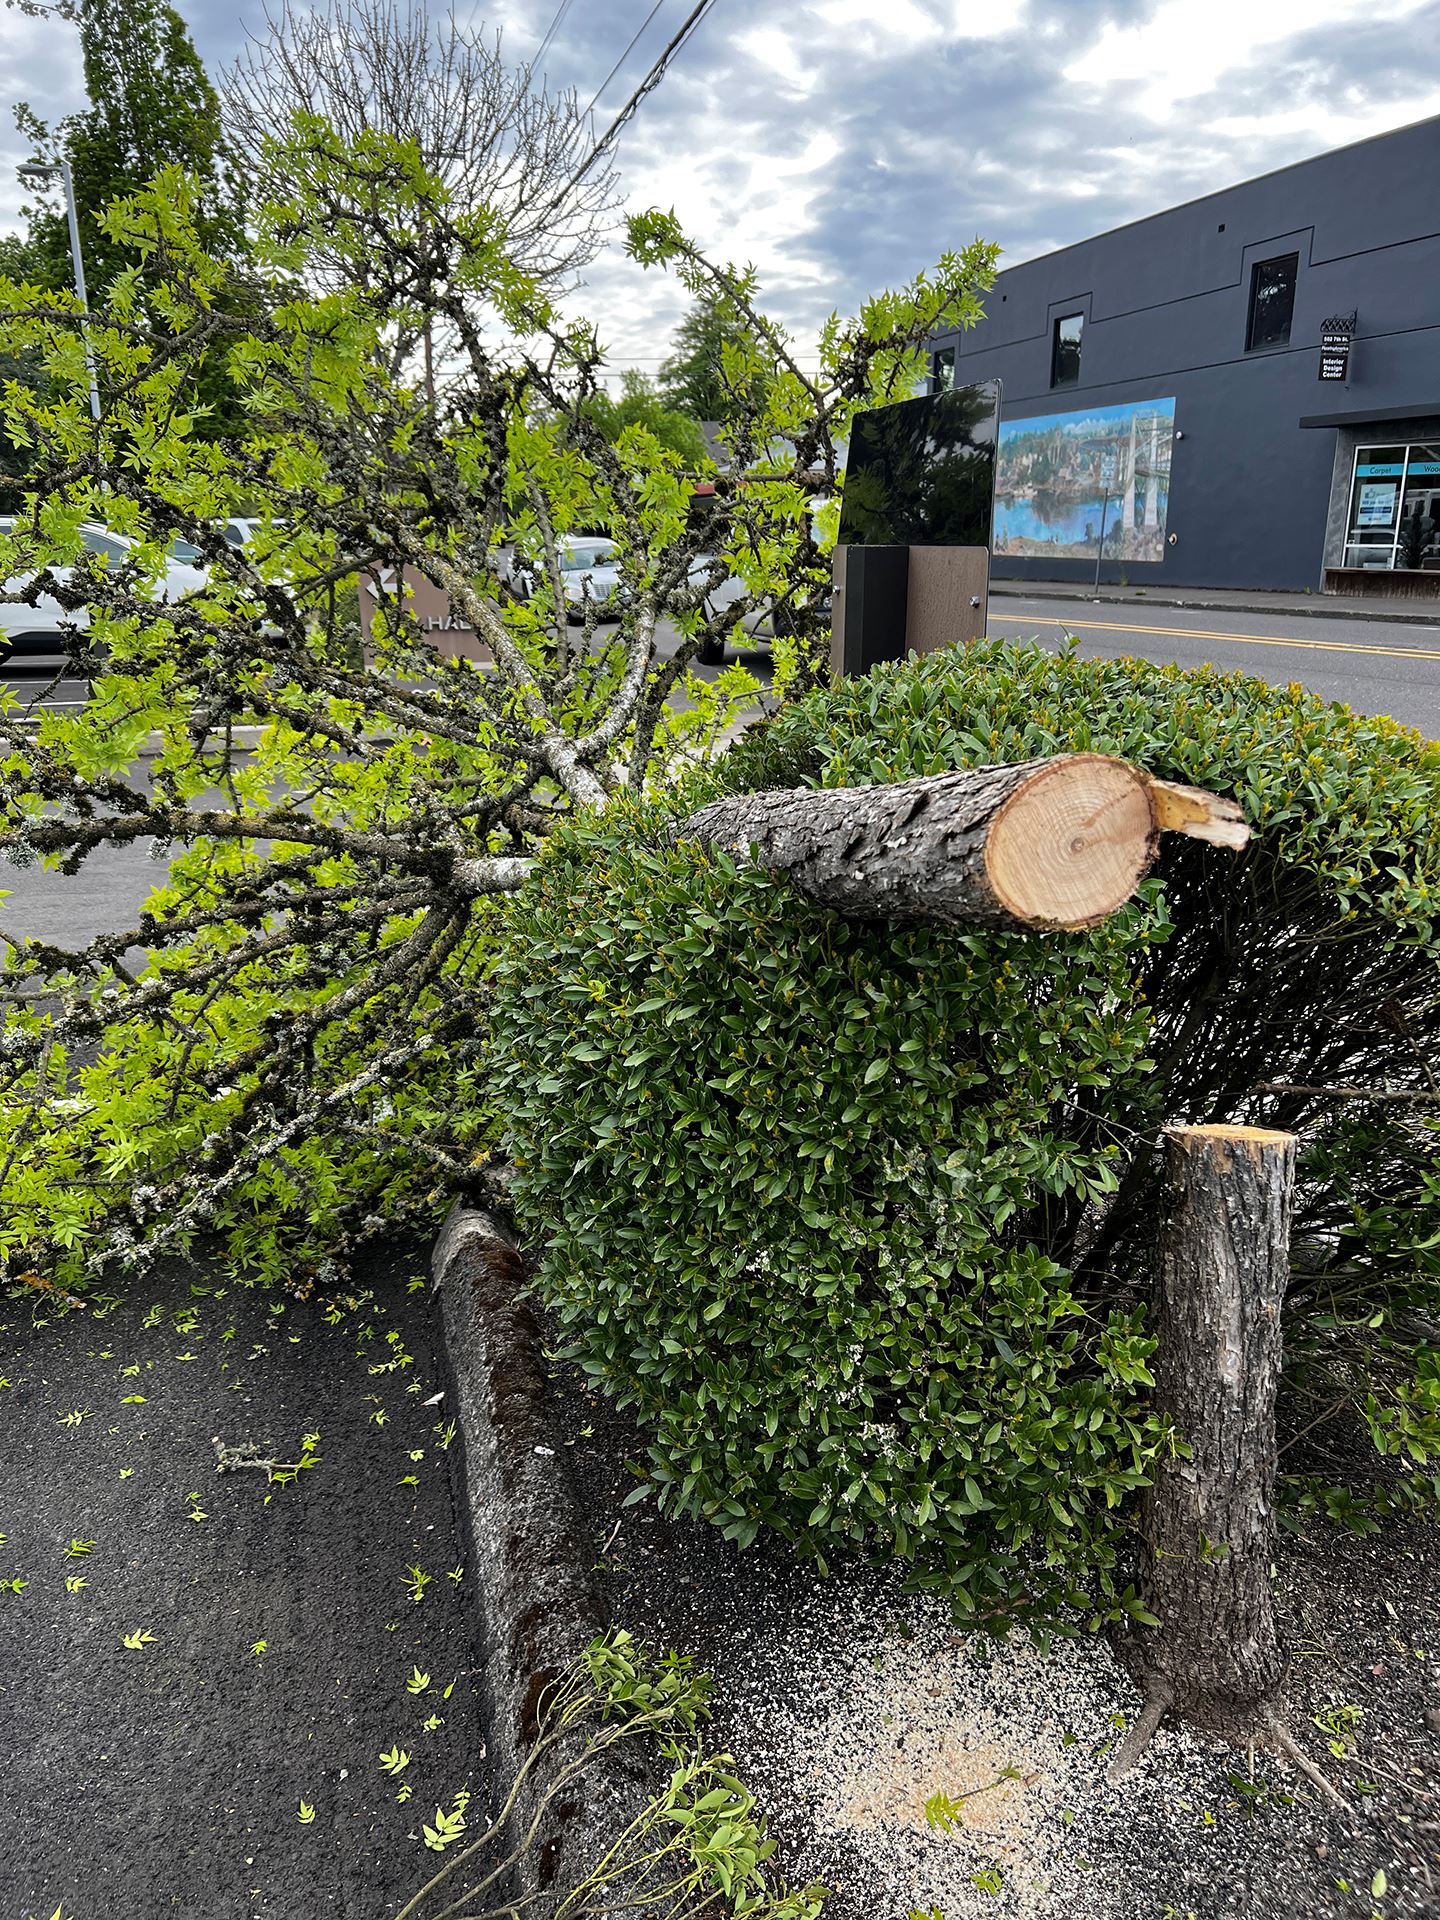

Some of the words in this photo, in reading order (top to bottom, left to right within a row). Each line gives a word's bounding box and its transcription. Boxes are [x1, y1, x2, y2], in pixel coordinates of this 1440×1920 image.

[1370, 467, 1392, 475] Carpet
[1424, 464, 1440, 473] Woo
[427, 615, 472, 631] HAL
